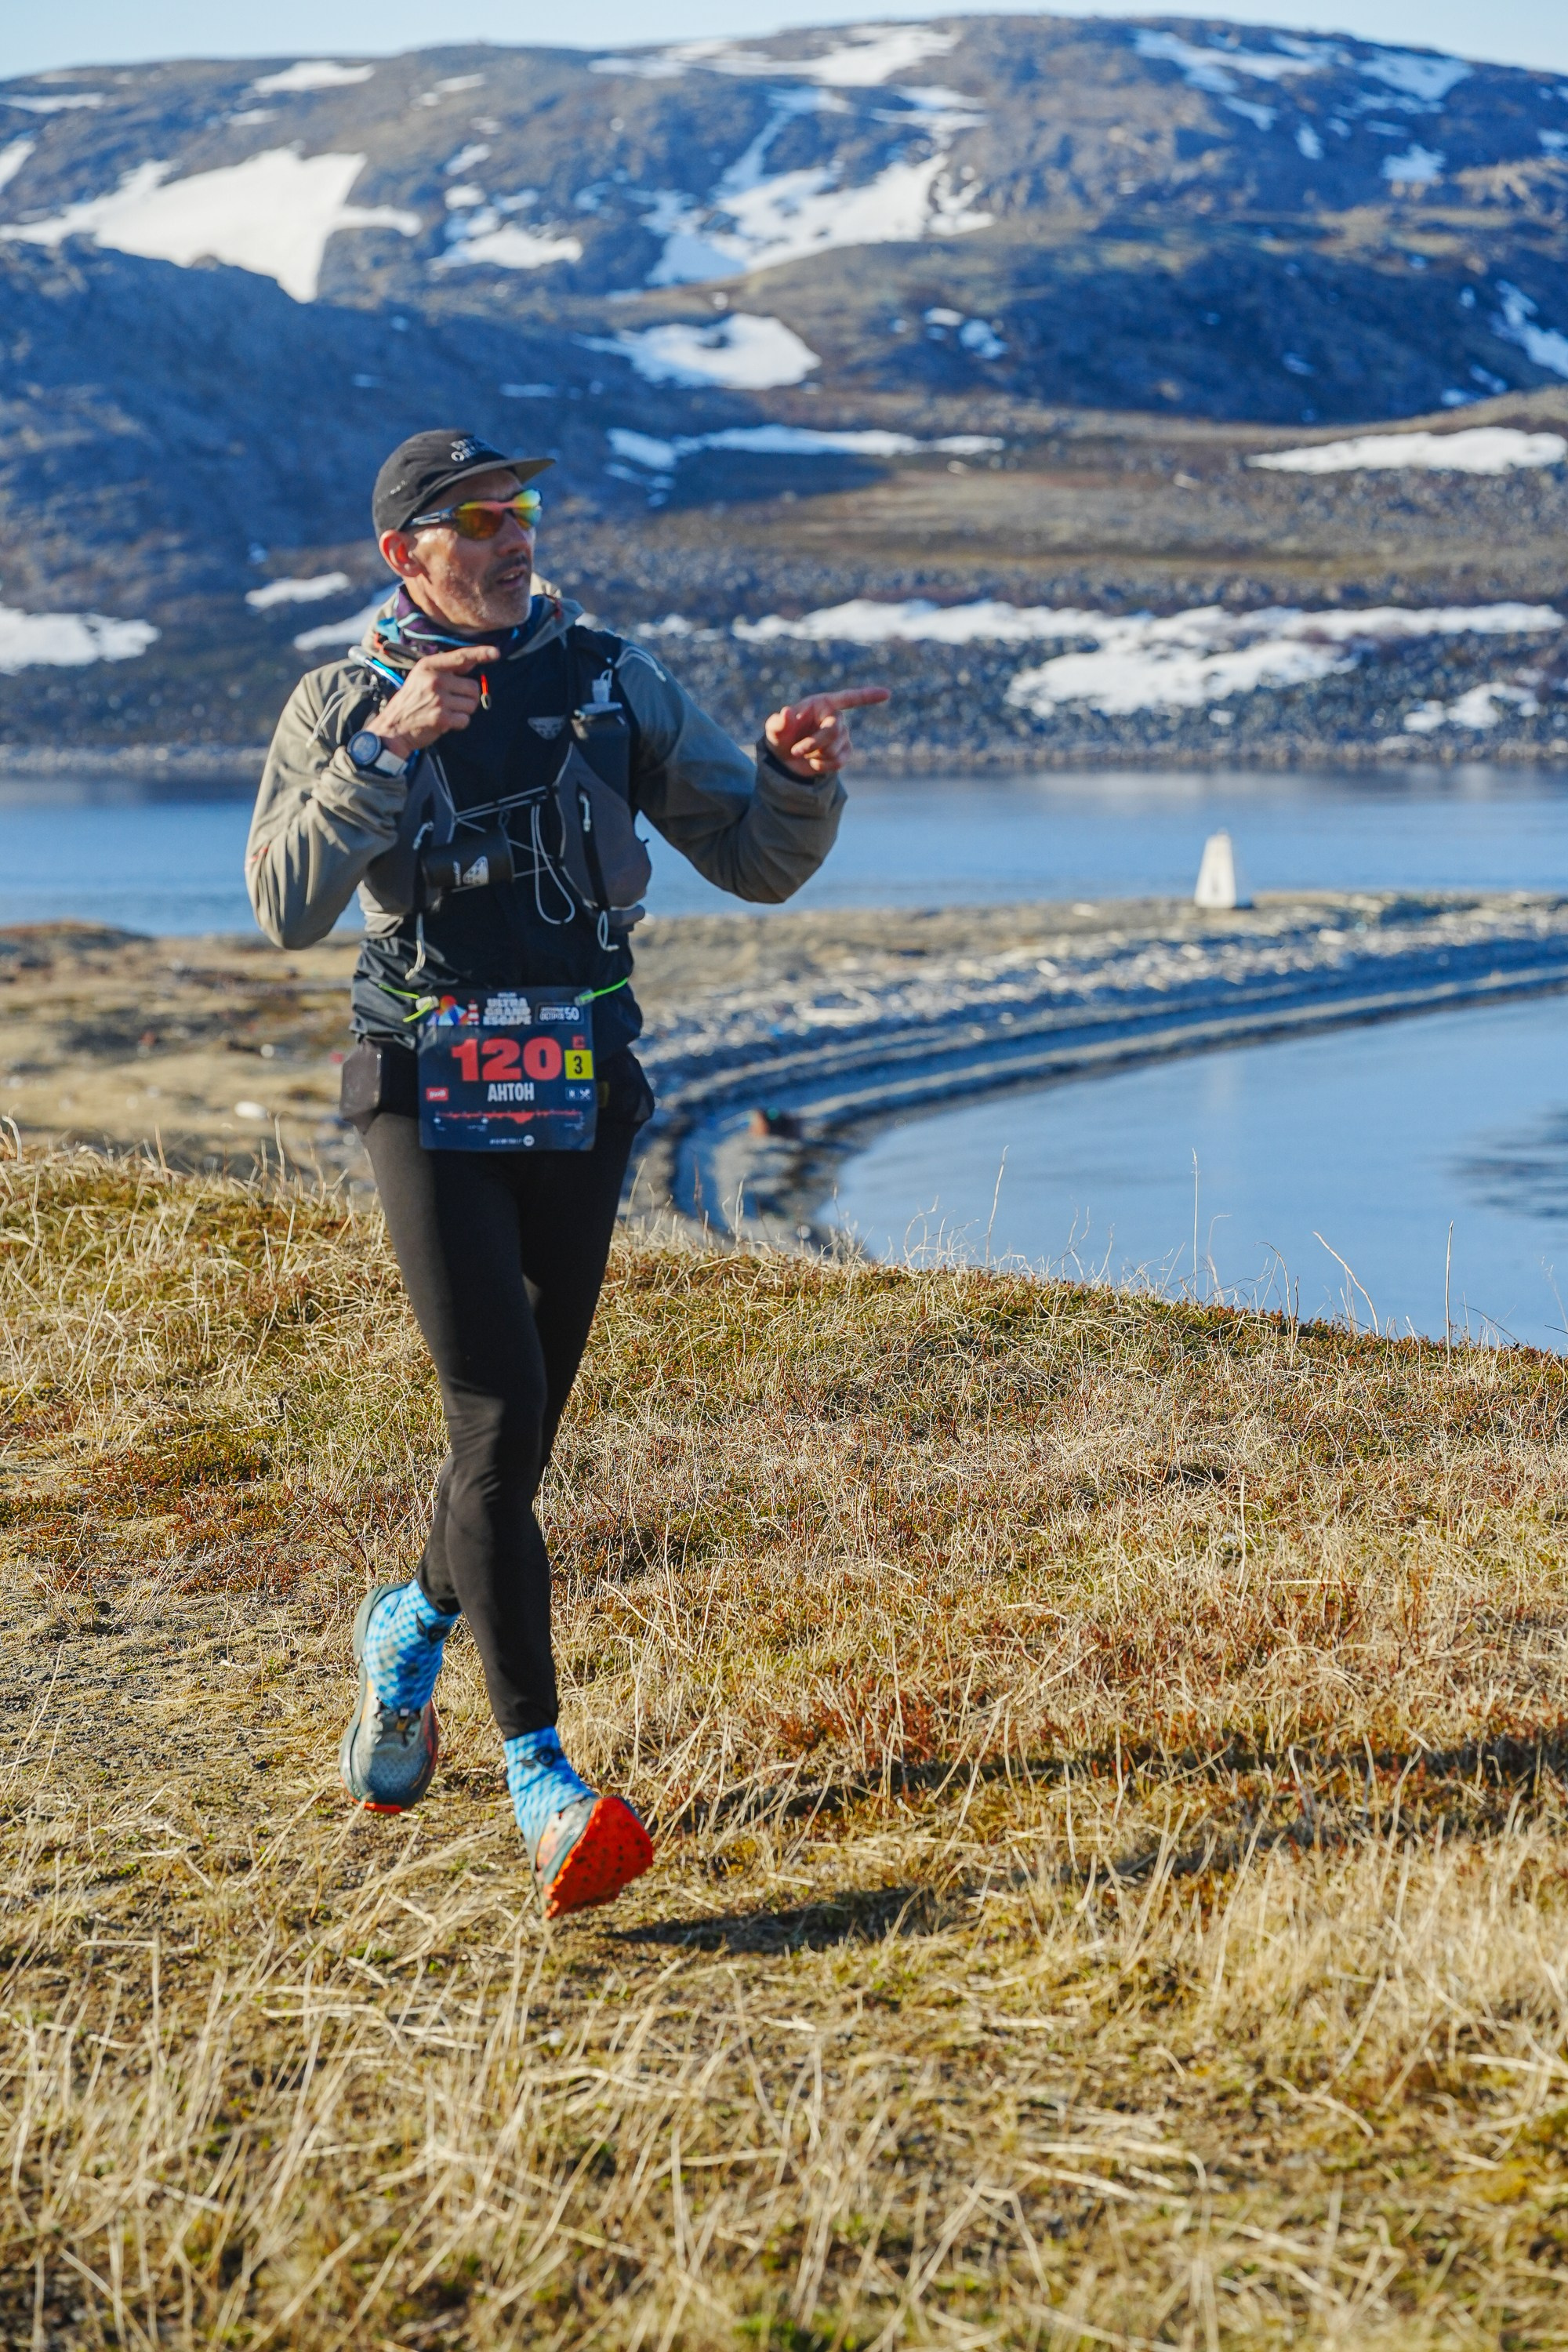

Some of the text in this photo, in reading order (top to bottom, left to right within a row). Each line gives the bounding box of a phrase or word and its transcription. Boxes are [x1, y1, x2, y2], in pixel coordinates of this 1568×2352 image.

[486, 998, 528, 1007] ULTRA
[483, 1015, 532, 1026] ESCAPE
[564, 1007, 580, 1021] 50
[452, 1036, 562, 1081] 120
[573, 1054, 583, 1074] 3
[487, 1083, 535, 1102] АНТОН
